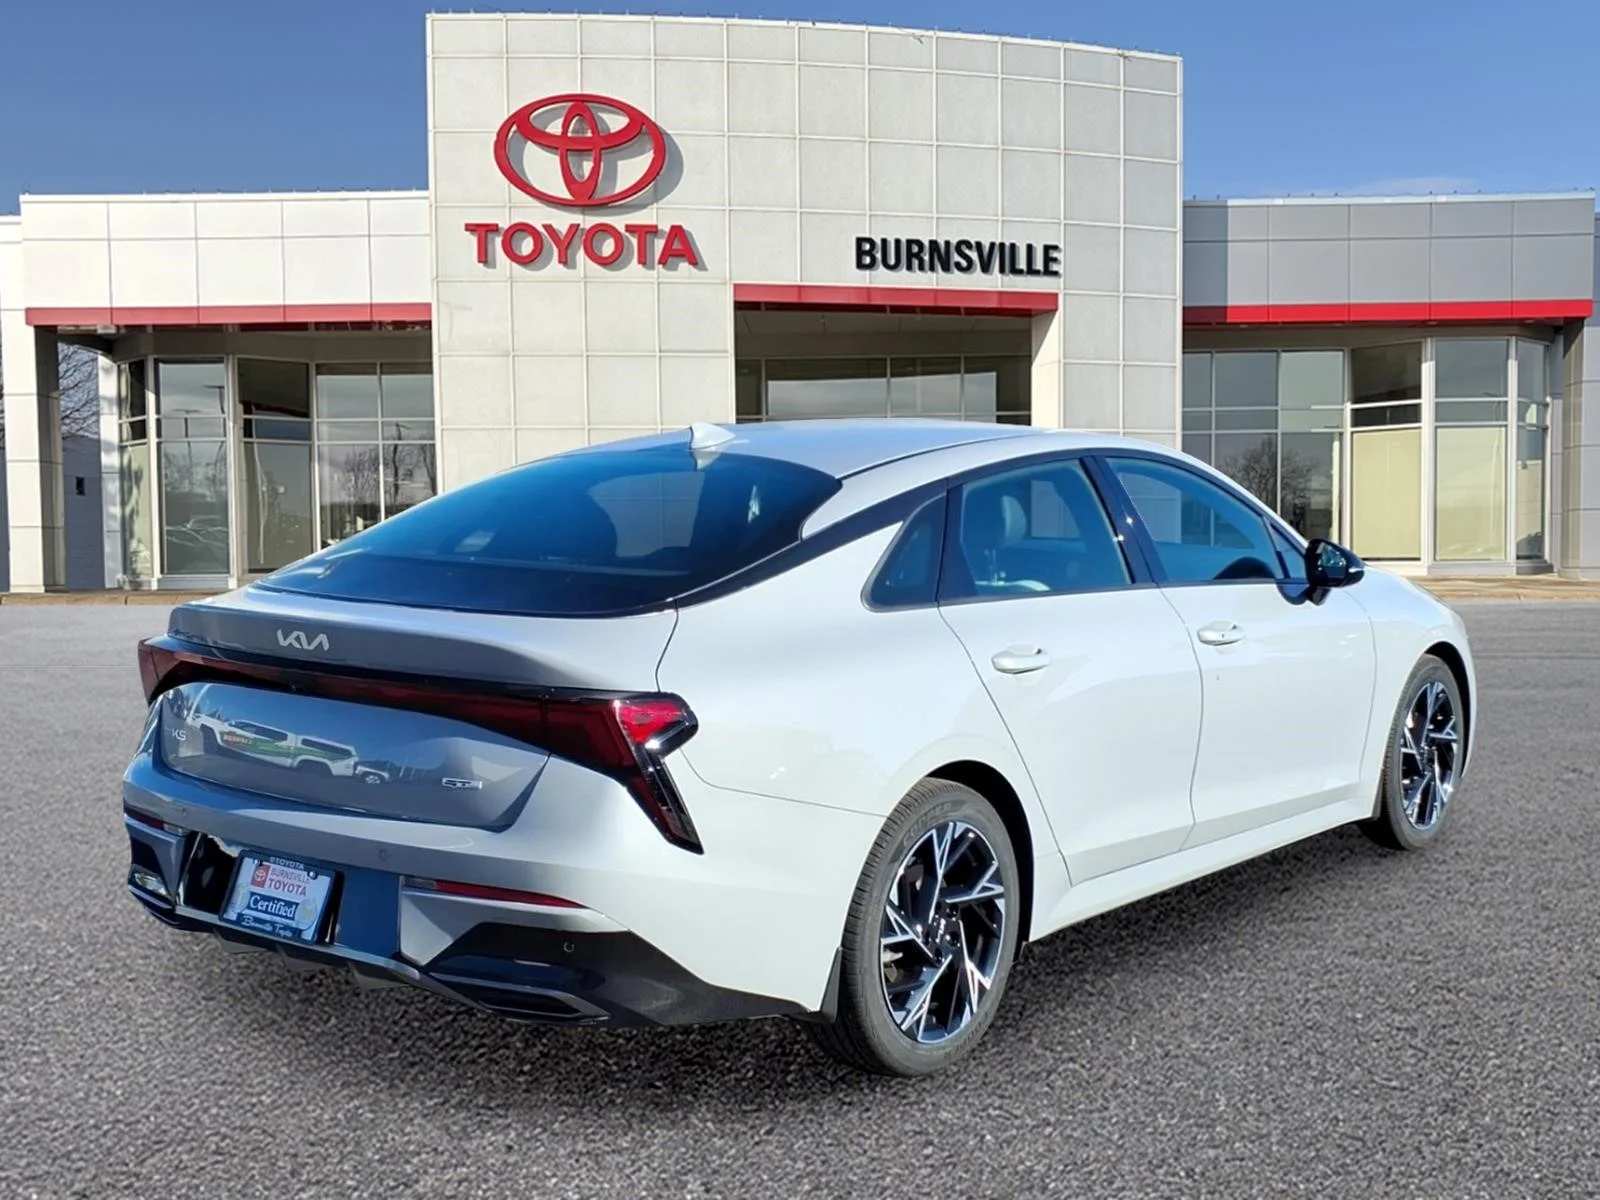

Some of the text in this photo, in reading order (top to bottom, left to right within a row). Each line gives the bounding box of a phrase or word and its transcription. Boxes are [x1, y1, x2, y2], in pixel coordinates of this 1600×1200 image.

[464, 222, 699, 267] TOYOTA
[855, 236, 1062, 277] BURNSVILLE
[268, 878, 307, 897] TOYOTA
[250, 895, 296, 918] Certified
